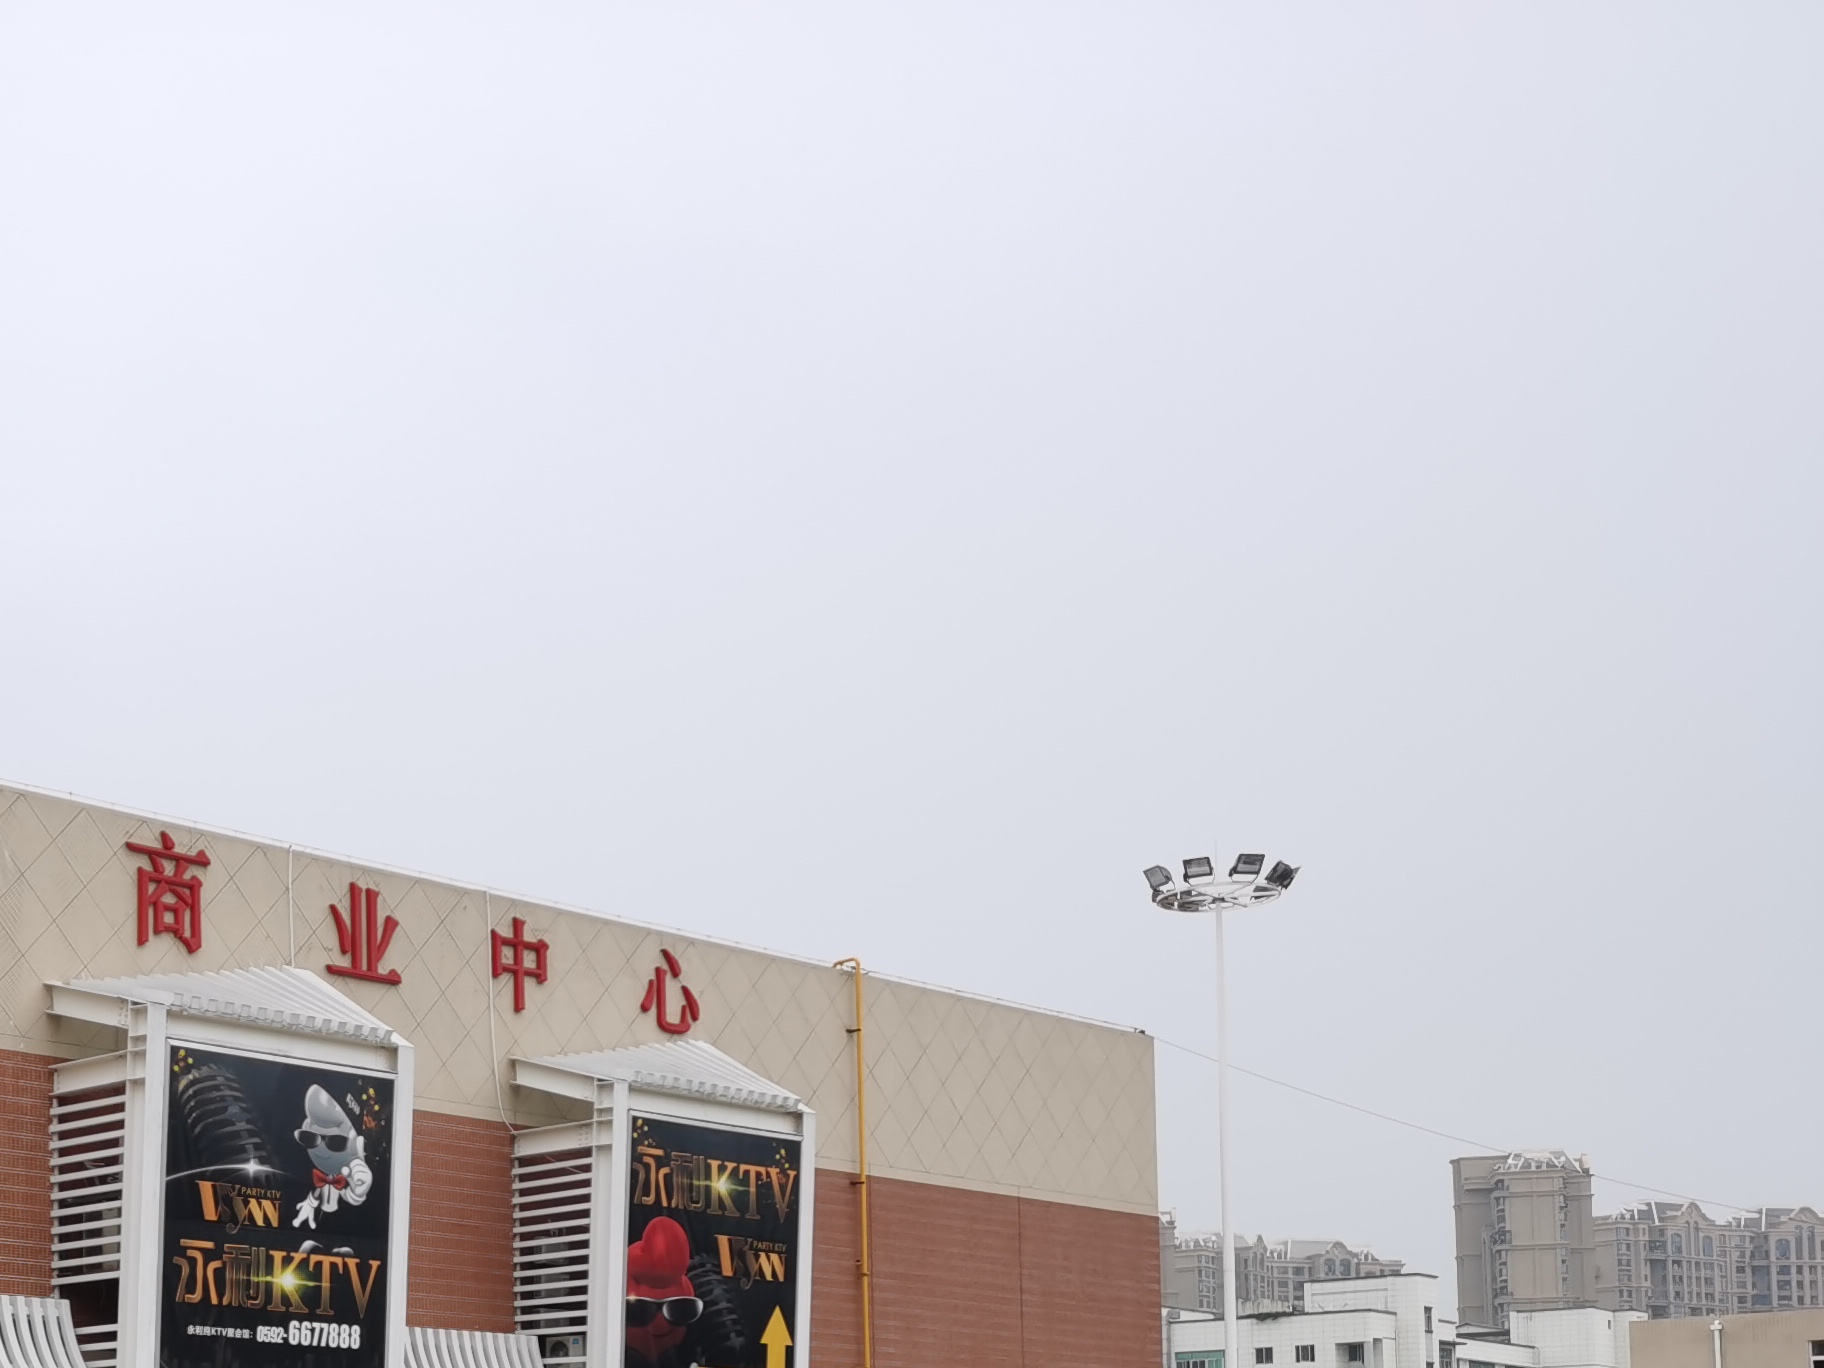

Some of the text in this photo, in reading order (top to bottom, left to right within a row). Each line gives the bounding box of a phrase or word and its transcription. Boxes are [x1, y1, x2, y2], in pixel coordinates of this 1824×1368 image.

[241, 1186, 282, 1199] PARTY KTV
[256, 1320, 361, 1350] 0592-6677888
